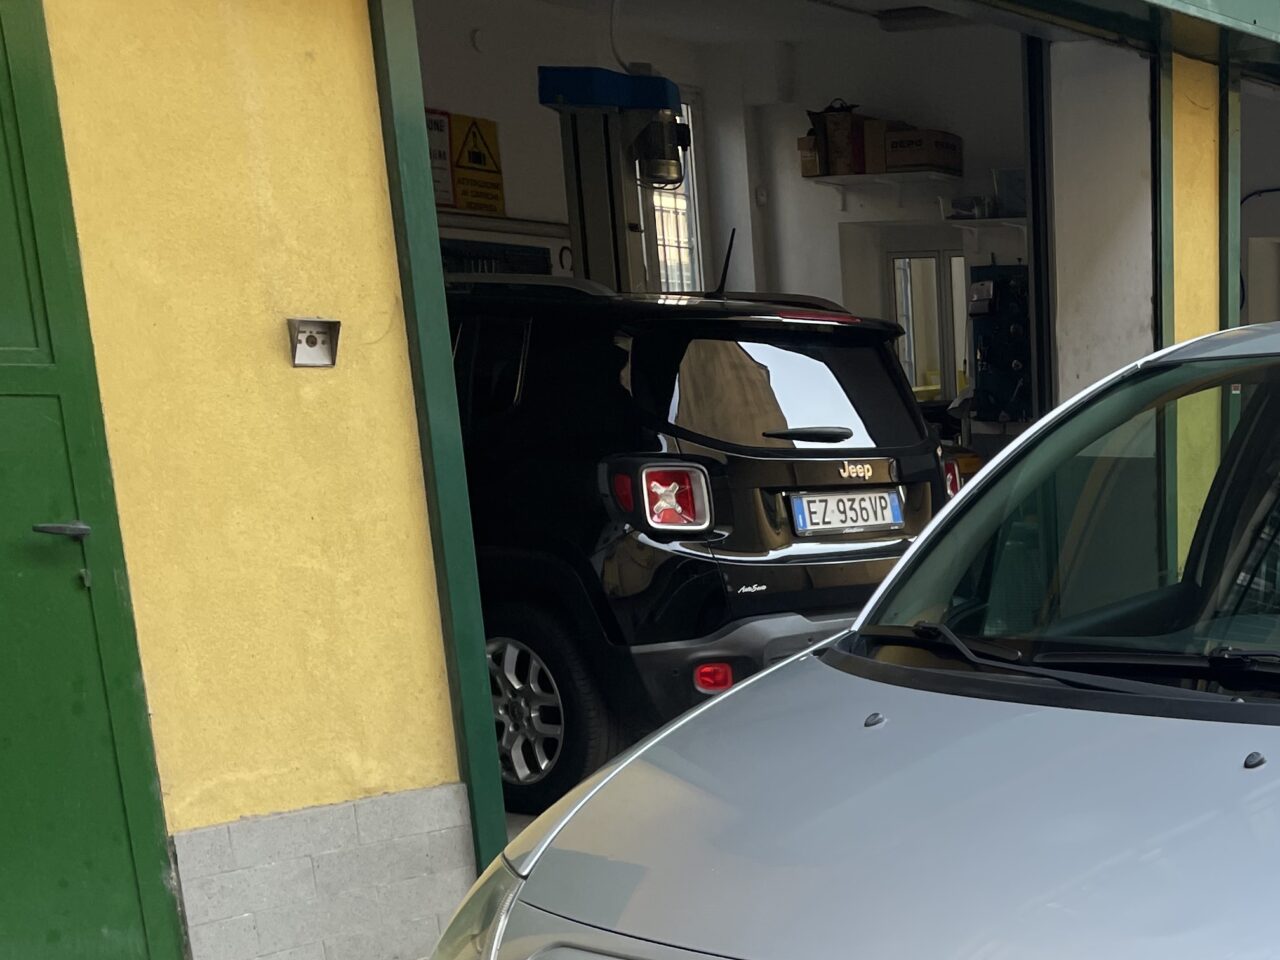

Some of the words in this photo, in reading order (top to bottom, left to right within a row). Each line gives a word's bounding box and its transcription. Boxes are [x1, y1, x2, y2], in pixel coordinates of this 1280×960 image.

[839, 461, 873, 480] Jeep
[806, 499, 832, 526] EZ
[836, 495, 889, 525] 936VP
